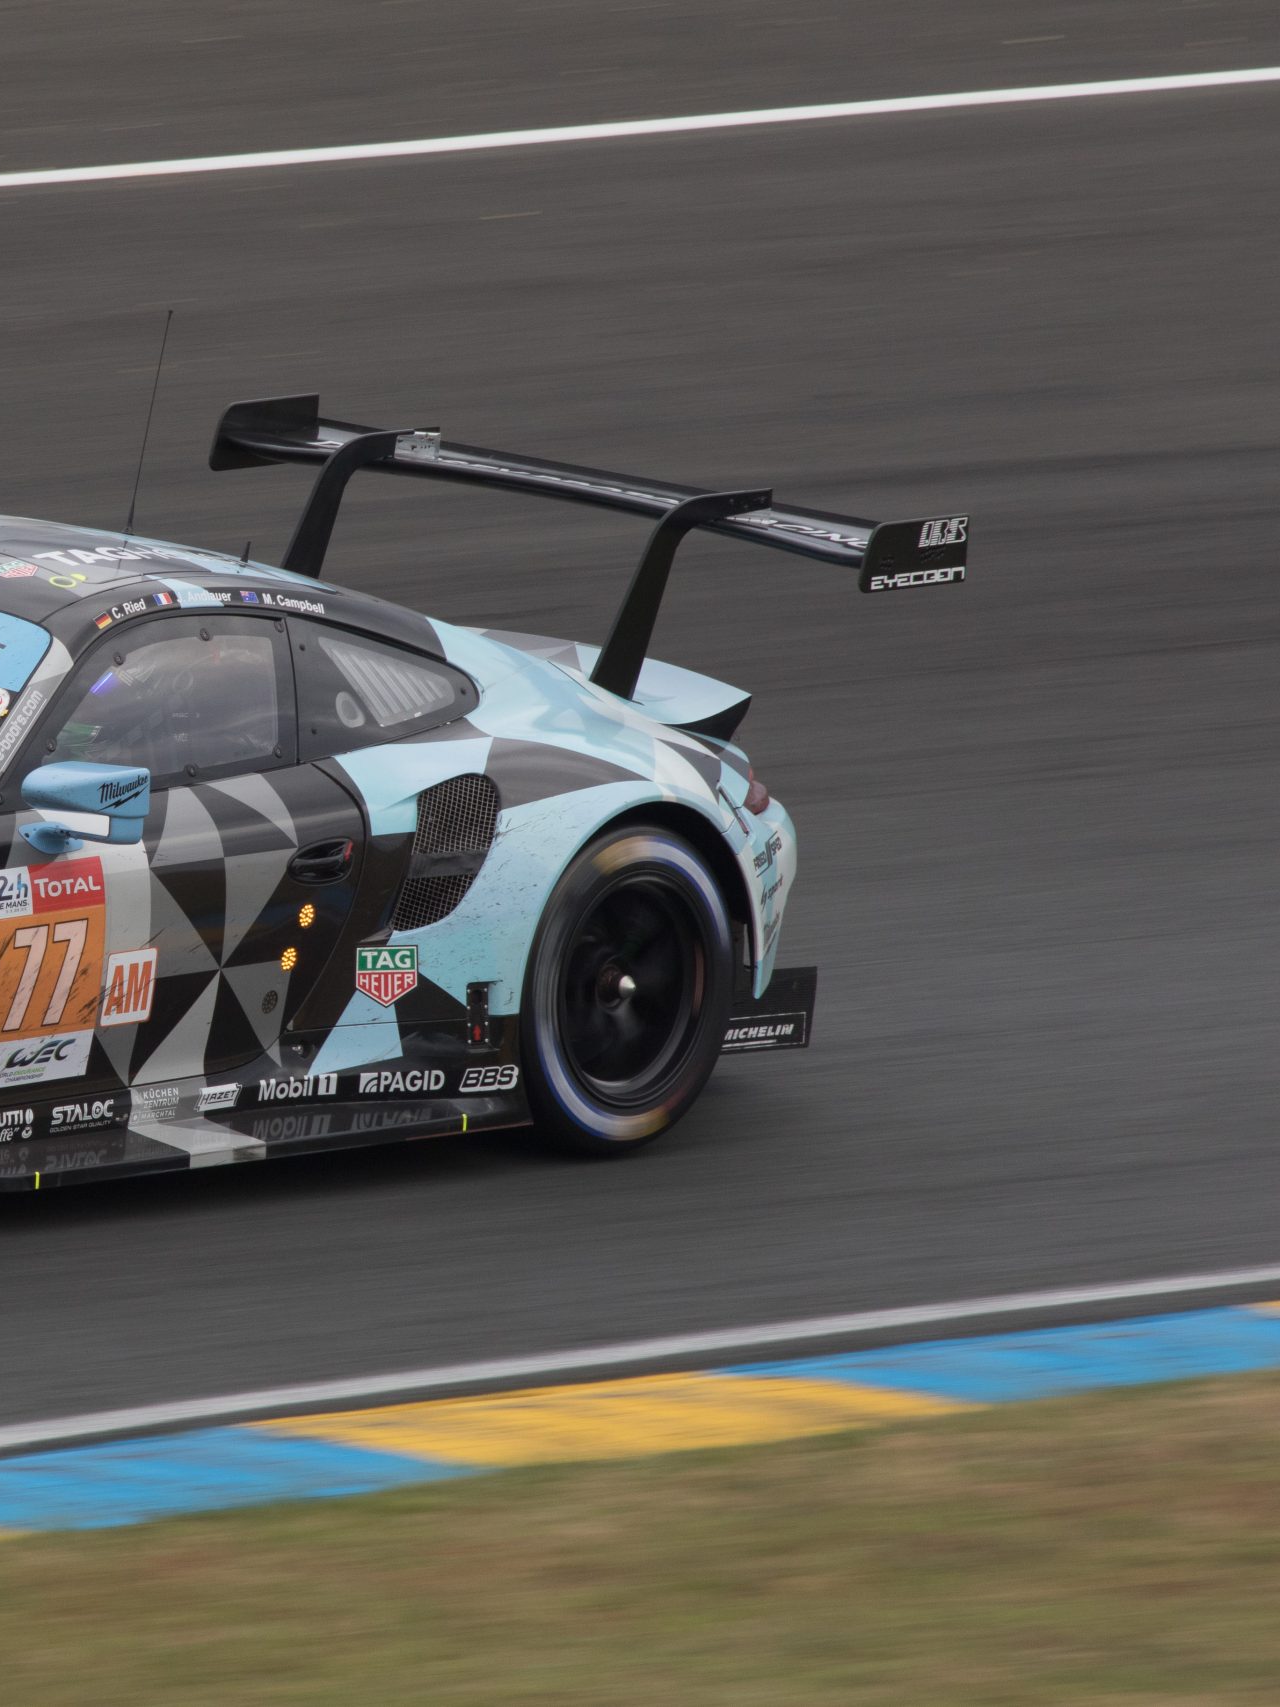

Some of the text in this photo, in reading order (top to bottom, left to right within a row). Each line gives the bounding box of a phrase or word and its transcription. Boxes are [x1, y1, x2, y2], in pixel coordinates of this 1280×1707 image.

[112, 599, 147, 620] C. Ried
[262, 593, 325, 615] M. Campbell
[97, 775, 149, 803] Milwaukee
[33, 875, 101, 898] TOTAL
[6, 899, 28, 910] MANS
[362, 950, 411, 968] TAG
[2, 918, 89, 1032] 77
[104, 961, 152, 1016] AM
[359, 973, 414, 1001] HEUER
[258, 1077, 312, 1101] Mobil
[380, 1070, 445, 1092] PAGID
[460, 1066, 518, 1092] BBS
[143, 1087, 179, 1099] KÜCHEN
[143, 1097, 180, 1109] ZENTRUM
[51, 1099, 114, 1125] STALOC
